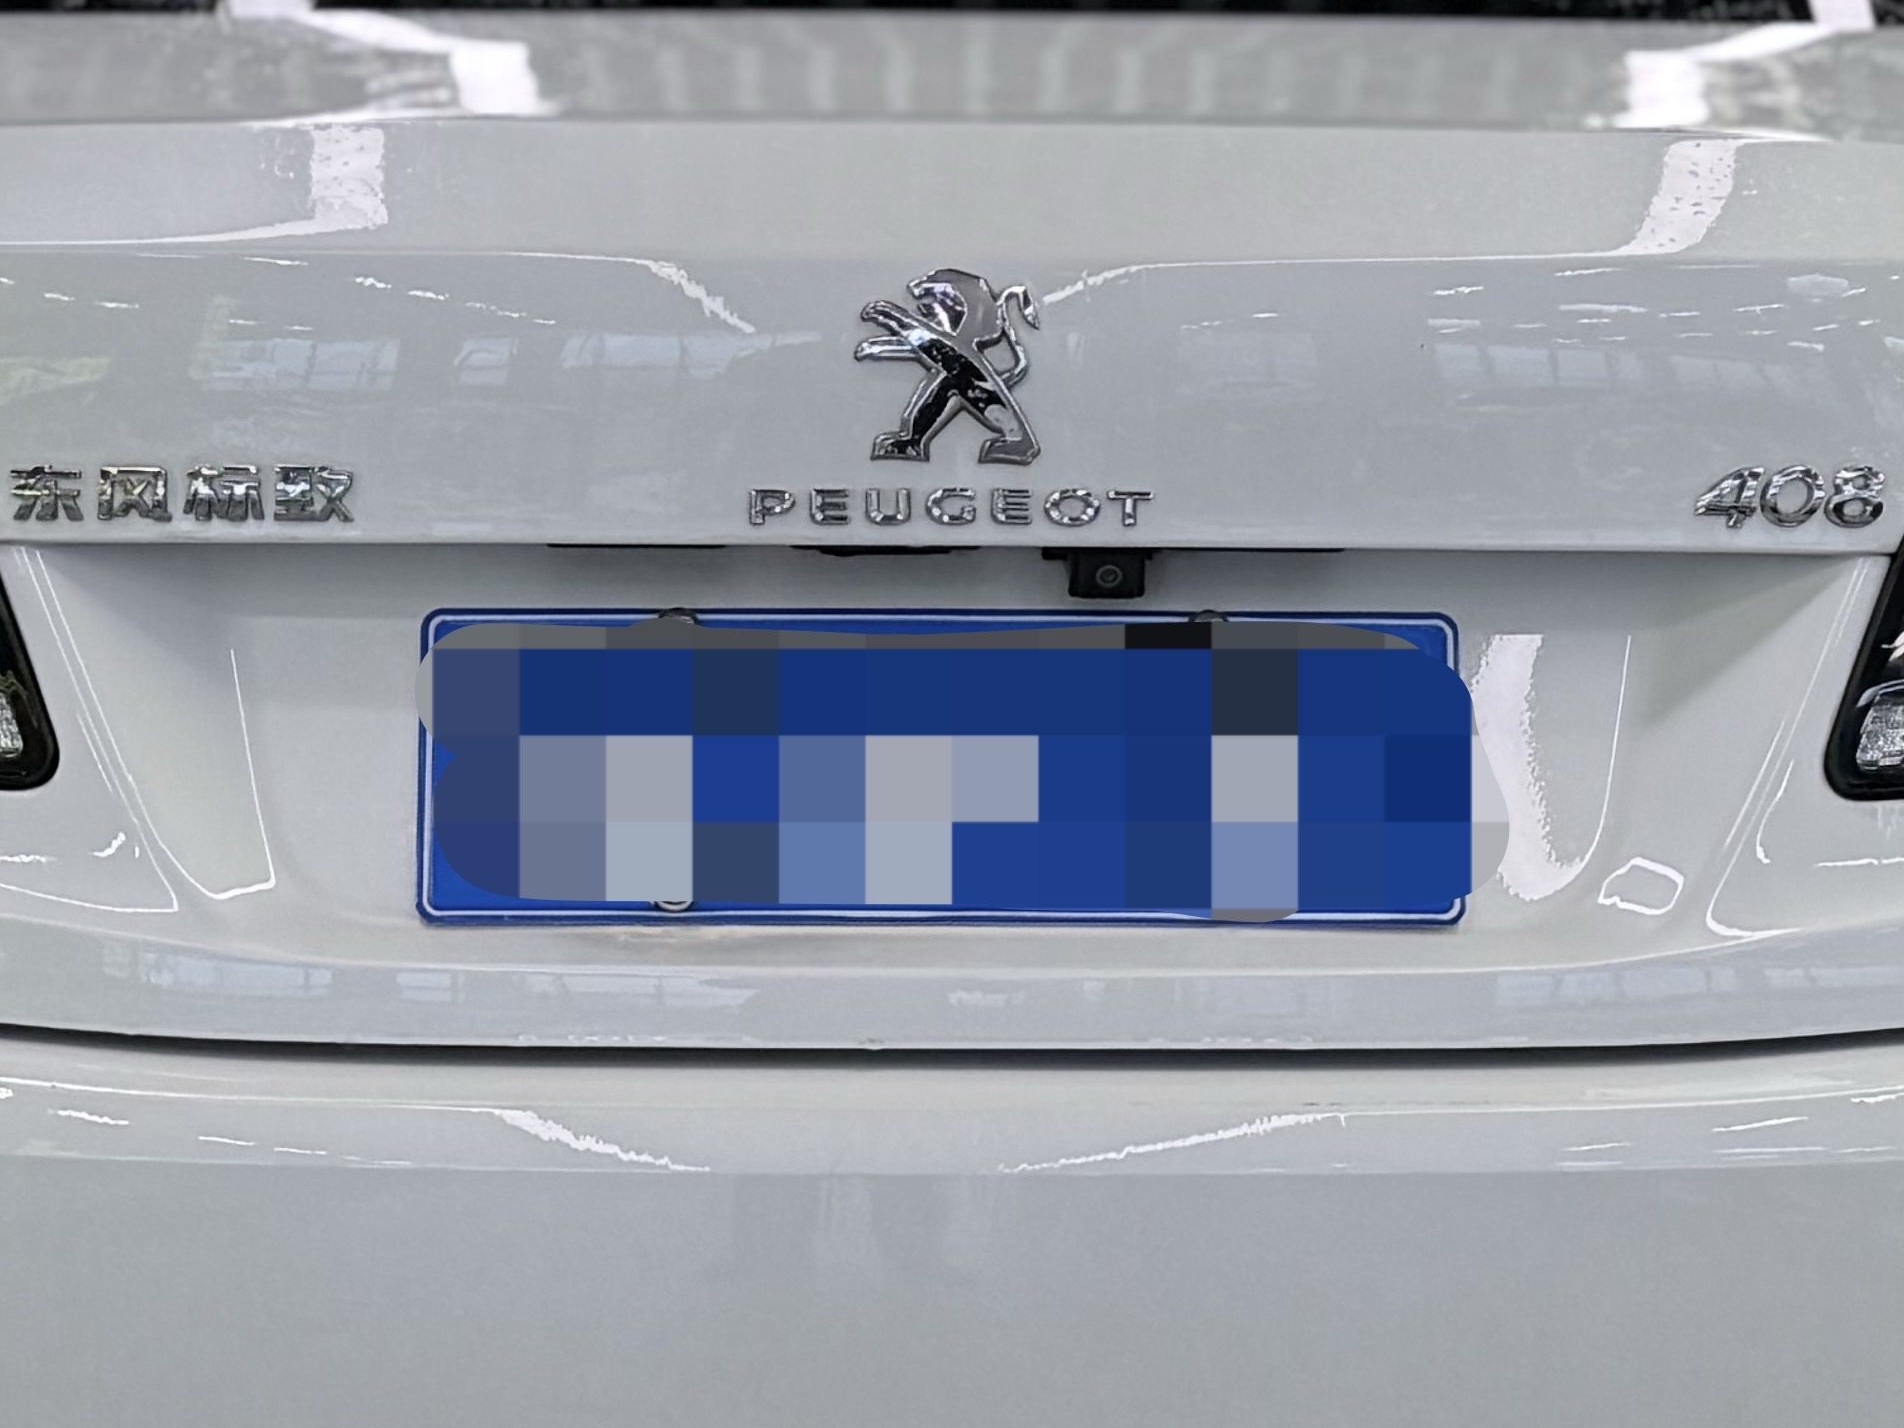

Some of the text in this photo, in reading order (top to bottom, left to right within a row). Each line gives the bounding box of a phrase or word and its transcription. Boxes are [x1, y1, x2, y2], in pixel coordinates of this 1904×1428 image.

[10, 464, 354, 523] 东风标致
[748, 487, 1154, 528] PEUGEOT
[1693, 465, 1886, 529] 408
